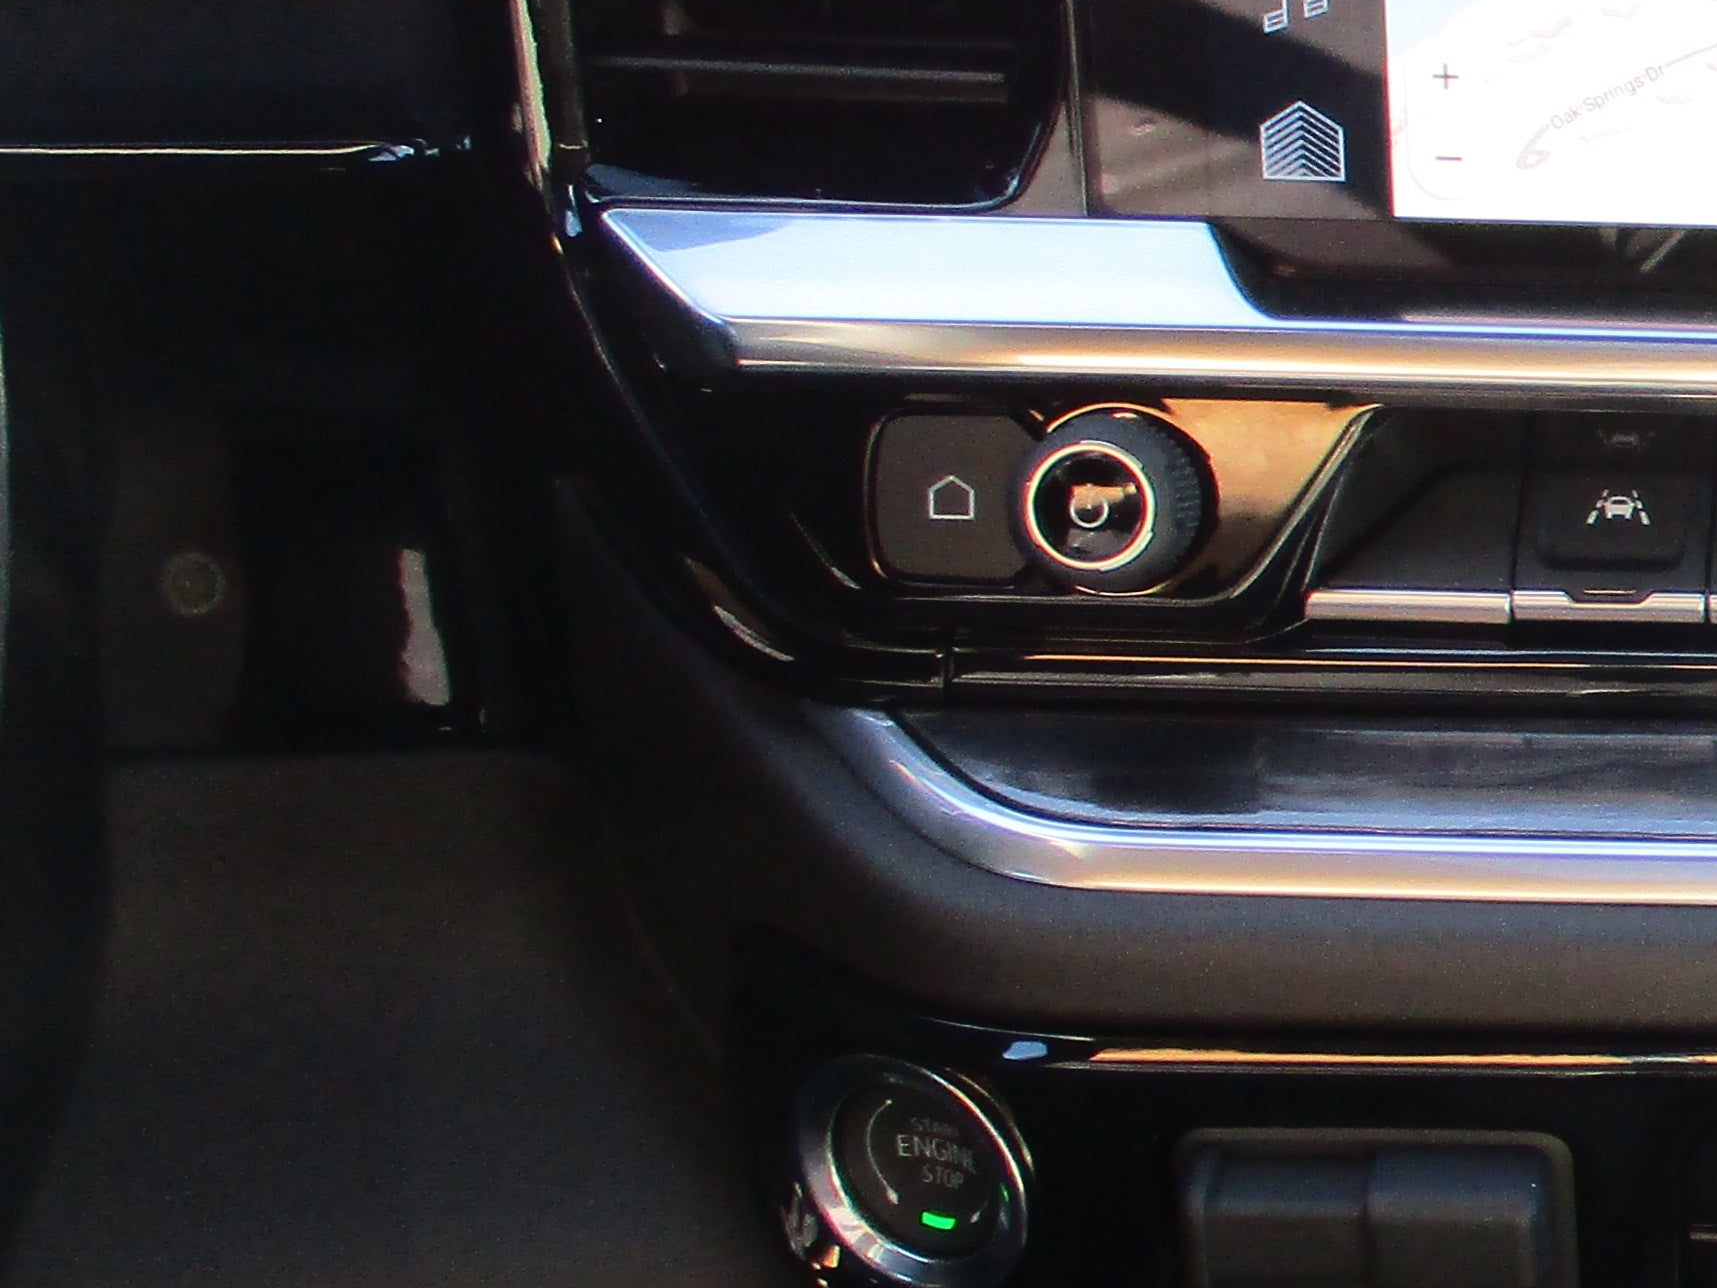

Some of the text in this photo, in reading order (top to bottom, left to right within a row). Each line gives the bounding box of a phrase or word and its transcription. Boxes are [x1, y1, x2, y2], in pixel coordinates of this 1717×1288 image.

[1549, 63, 1665, 130] Oak Springs Dr
[921, 1164, 965, 1189] STOP
